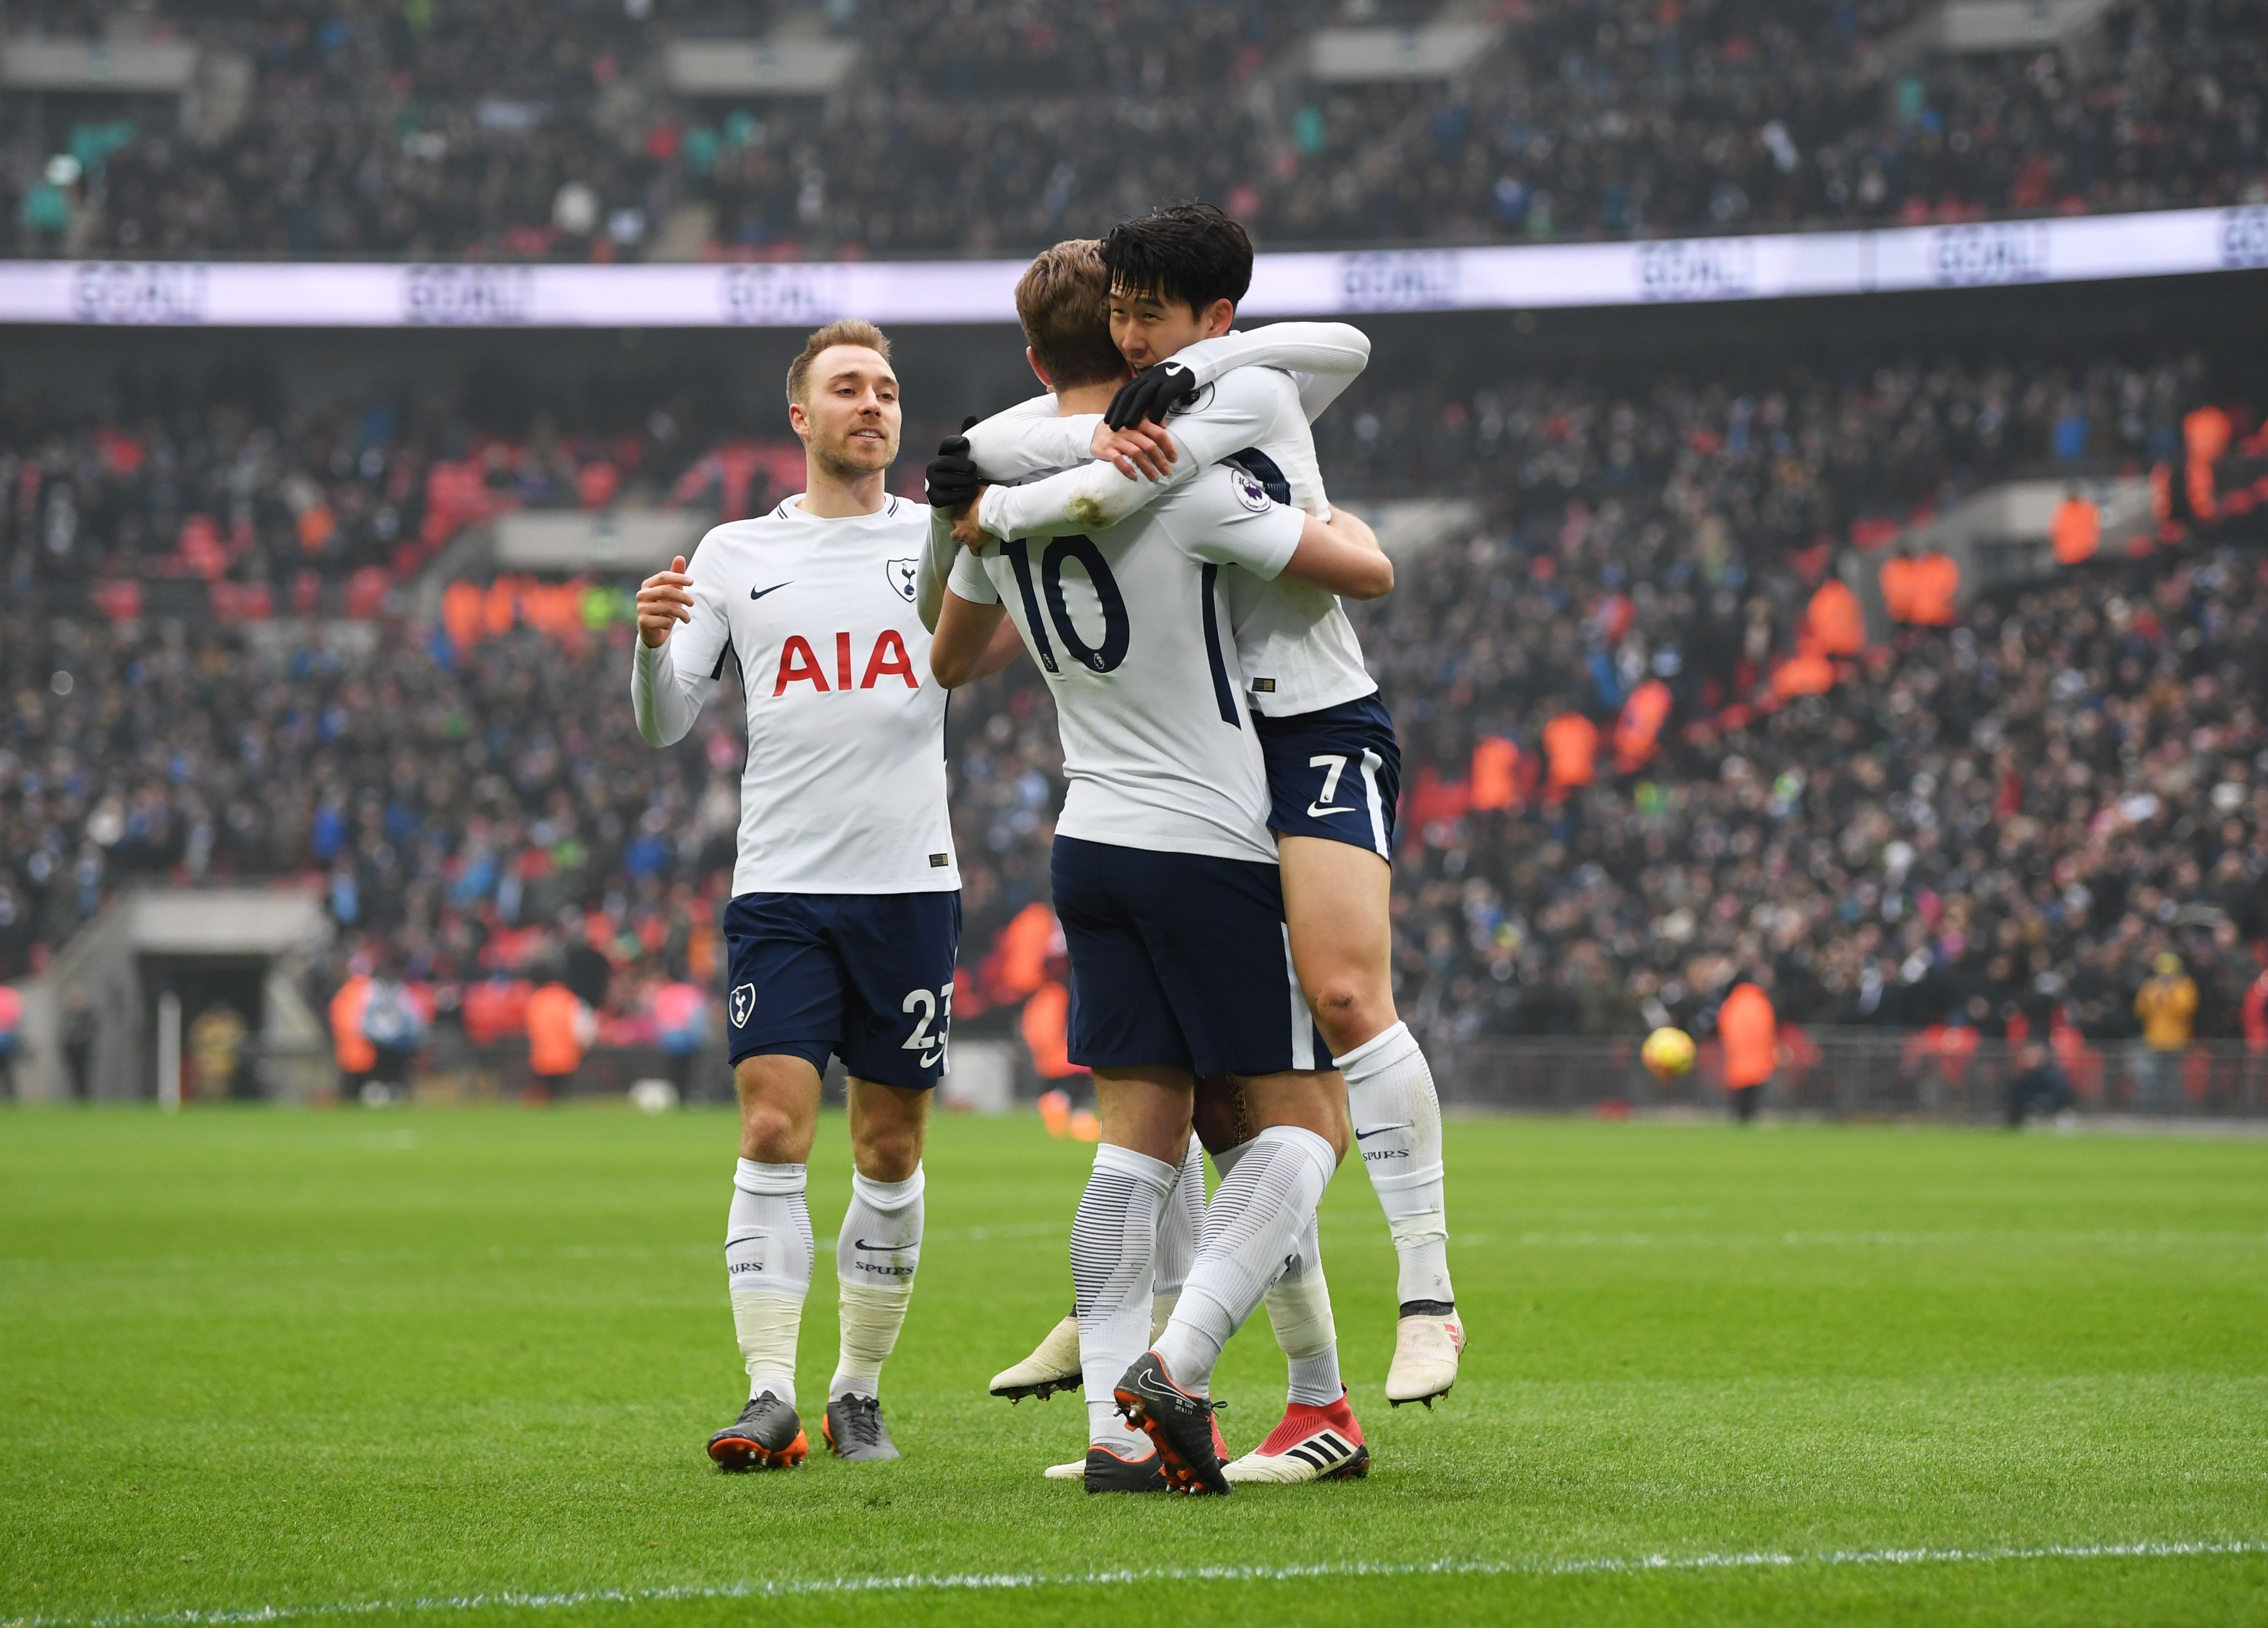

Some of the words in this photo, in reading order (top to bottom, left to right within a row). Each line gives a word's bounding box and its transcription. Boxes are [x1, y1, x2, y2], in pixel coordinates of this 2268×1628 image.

[1000, 534, 1130, 673] 10
[772, 629, 919, 697] AIA
[1309, 755, 1348, 803] 7
[1362, 1149, 1409, 1162] SPURS
[855, 1261, 914, 1275] SPURS
